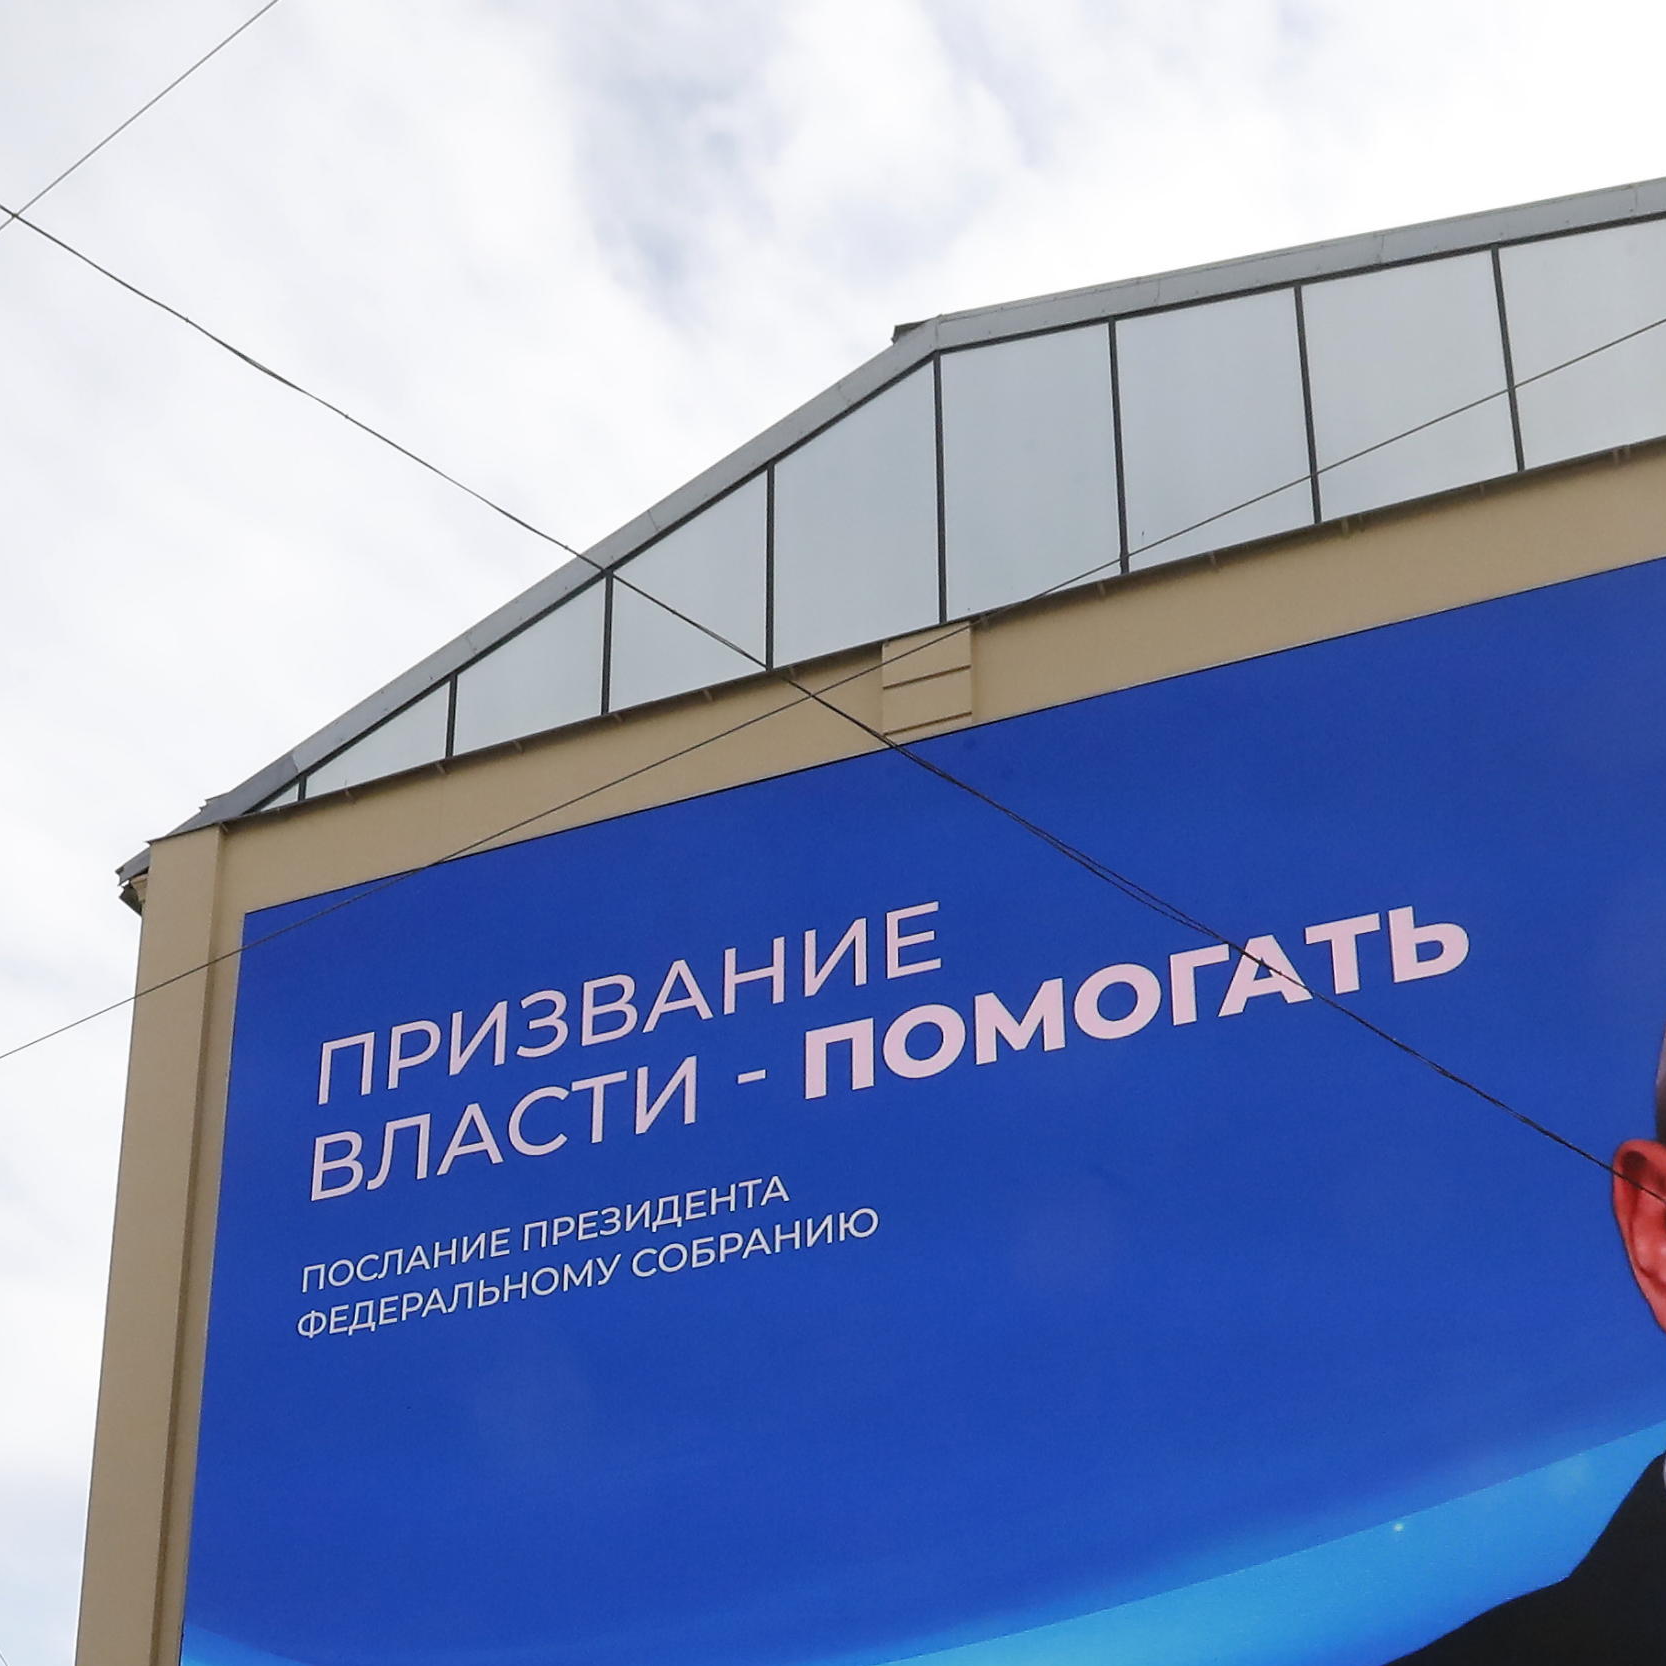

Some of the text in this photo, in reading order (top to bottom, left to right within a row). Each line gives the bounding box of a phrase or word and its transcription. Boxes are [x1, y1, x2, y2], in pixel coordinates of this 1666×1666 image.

[310, 1055, 697, 1202] ВЛАСТИ
[804, 905, 1470, 1100] ПОМОГАТЬ
[317, 901, 942, 1105] ПРИЗВАНИЕ
[297, 1207, 879, 1339] ФЕДЕРАЛЬНОМУ СОБРАНИЮ
[302, 1175, 790, 1293] ПОСЛАНИЕ ПРЕЗИДЕНТА
